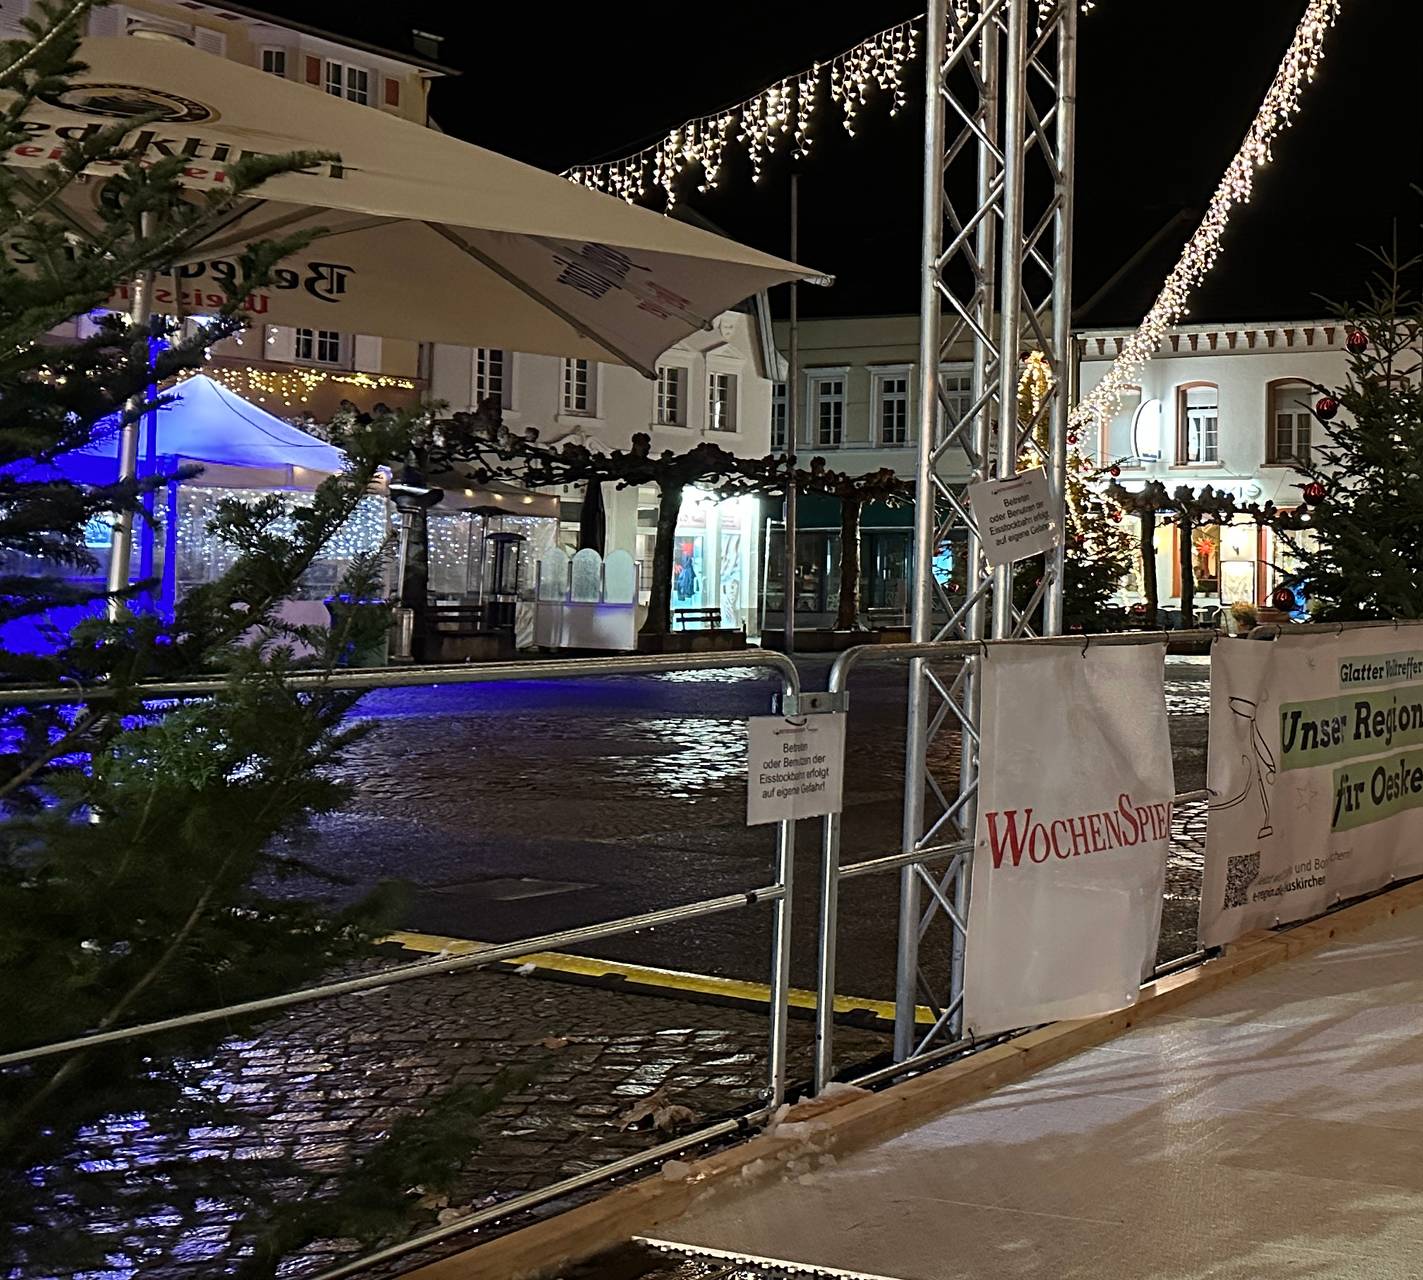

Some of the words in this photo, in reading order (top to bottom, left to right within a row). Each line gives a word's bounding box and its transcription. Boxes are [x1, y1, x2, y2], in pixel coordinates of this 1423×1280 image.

[1340, 662, 1384, 684] Glatter
[1282, 710, 1347, 754] Unser
[762, 760, 781, 769] oder
[812, 754, 826, 764] der
[761, 788, 775, 799] auf
